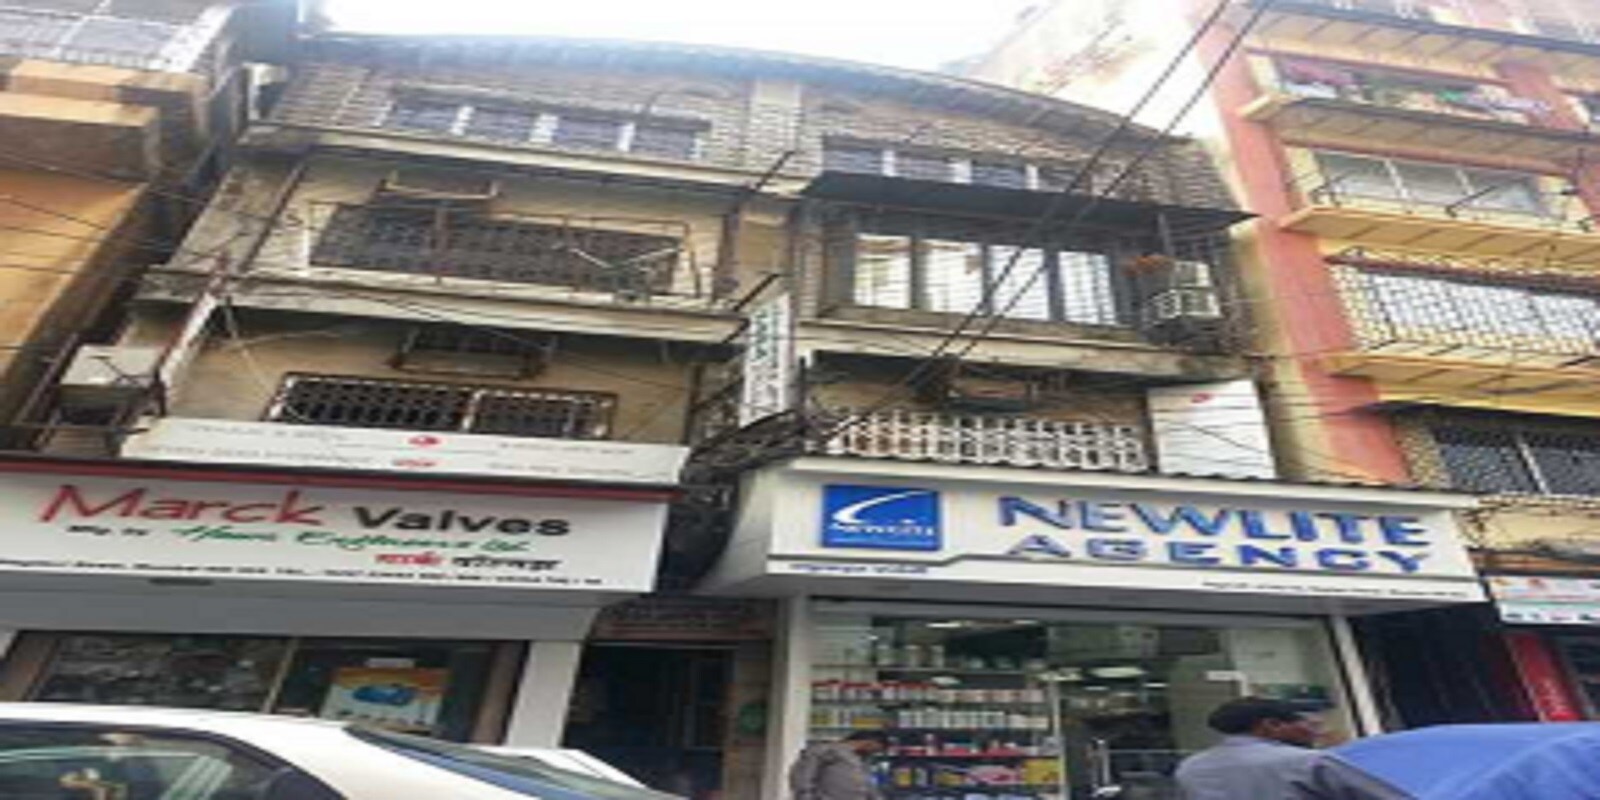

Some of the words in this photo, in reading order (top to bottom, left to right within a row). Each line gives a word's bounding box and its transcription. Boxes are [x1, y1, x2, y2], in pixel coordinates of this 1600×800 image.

[38, 483, 325, 526] Marck
[353, 506, 571, 536] Valves
[998, 495, 1429, 547] NEWLITE
[1006, 534, 1427, 572] AGENCY
